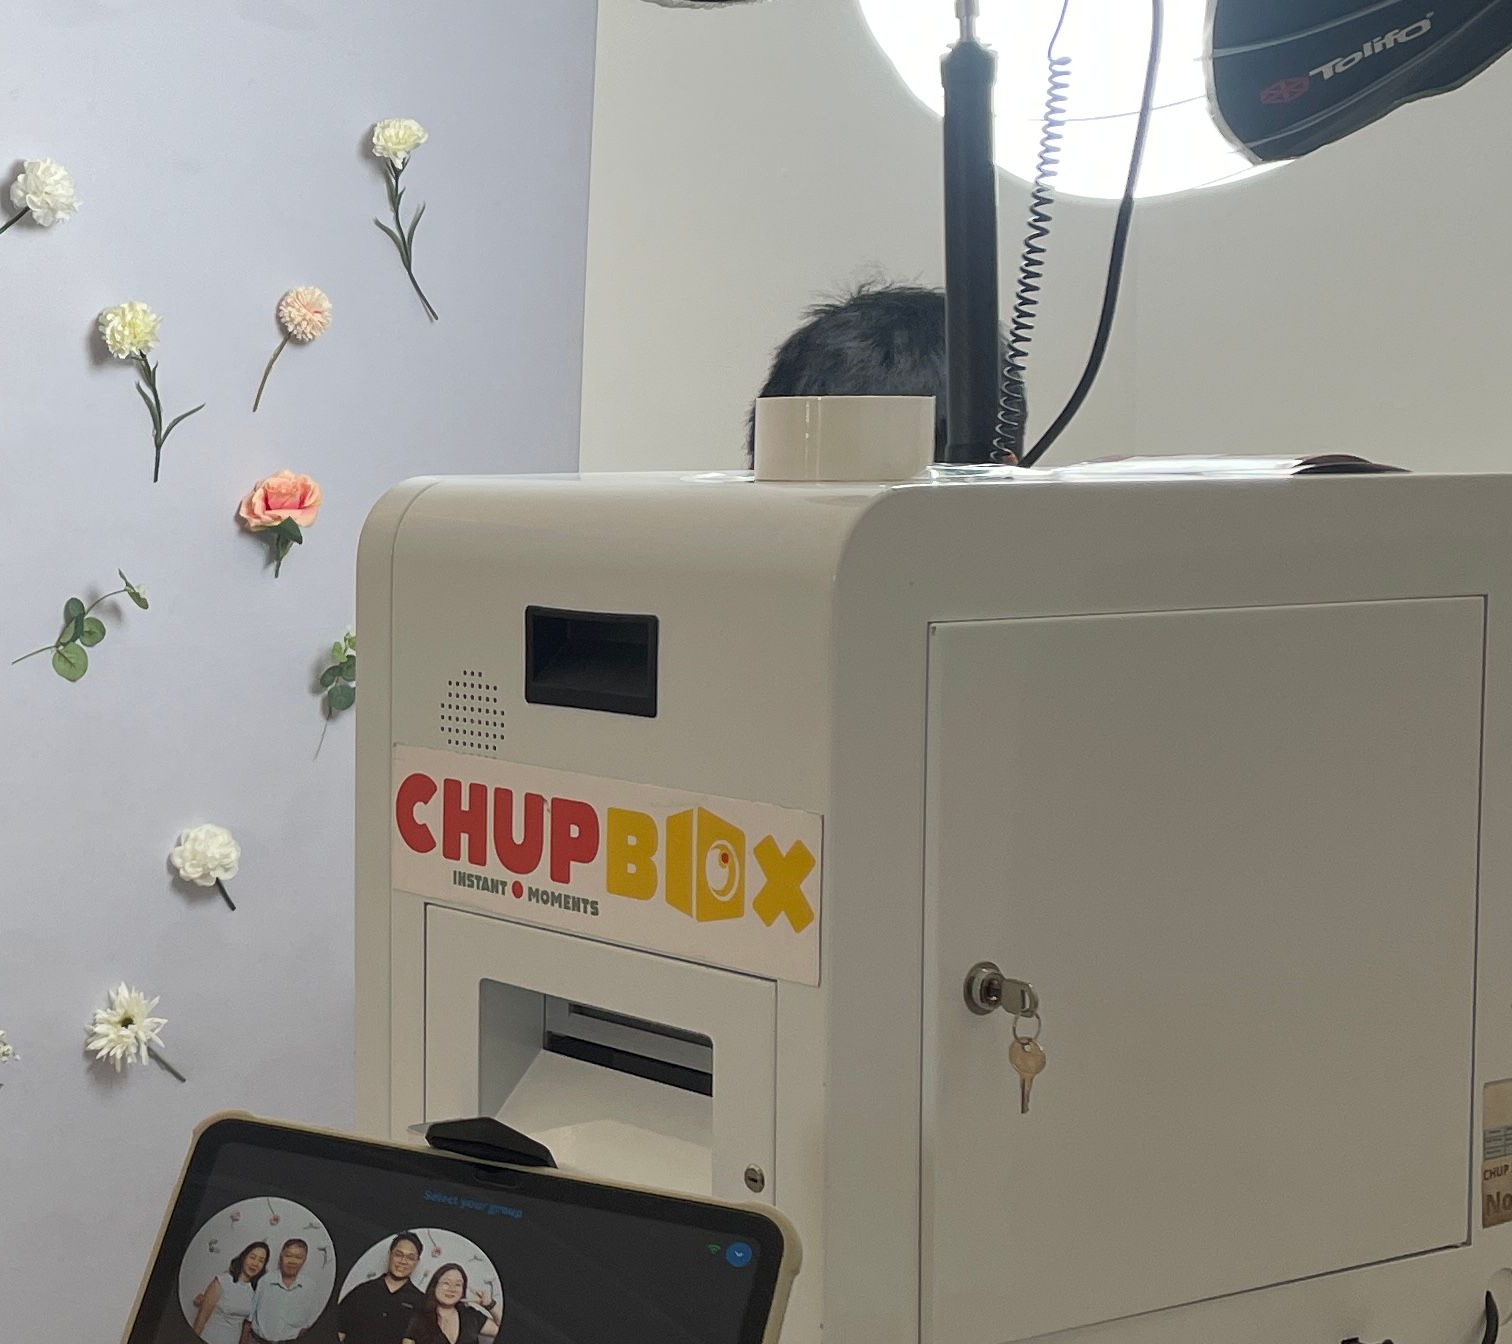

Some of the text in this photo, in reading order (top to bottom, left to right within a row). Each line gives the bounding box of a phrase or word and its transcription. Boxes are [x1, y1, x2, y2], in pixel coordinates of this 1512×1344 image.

[1308, 17, 1432, 81] Tolifo
[453, 870, 599, 916] INSTANT MOMENTS
[1483, 1164, 1509, 1181] CHUP
